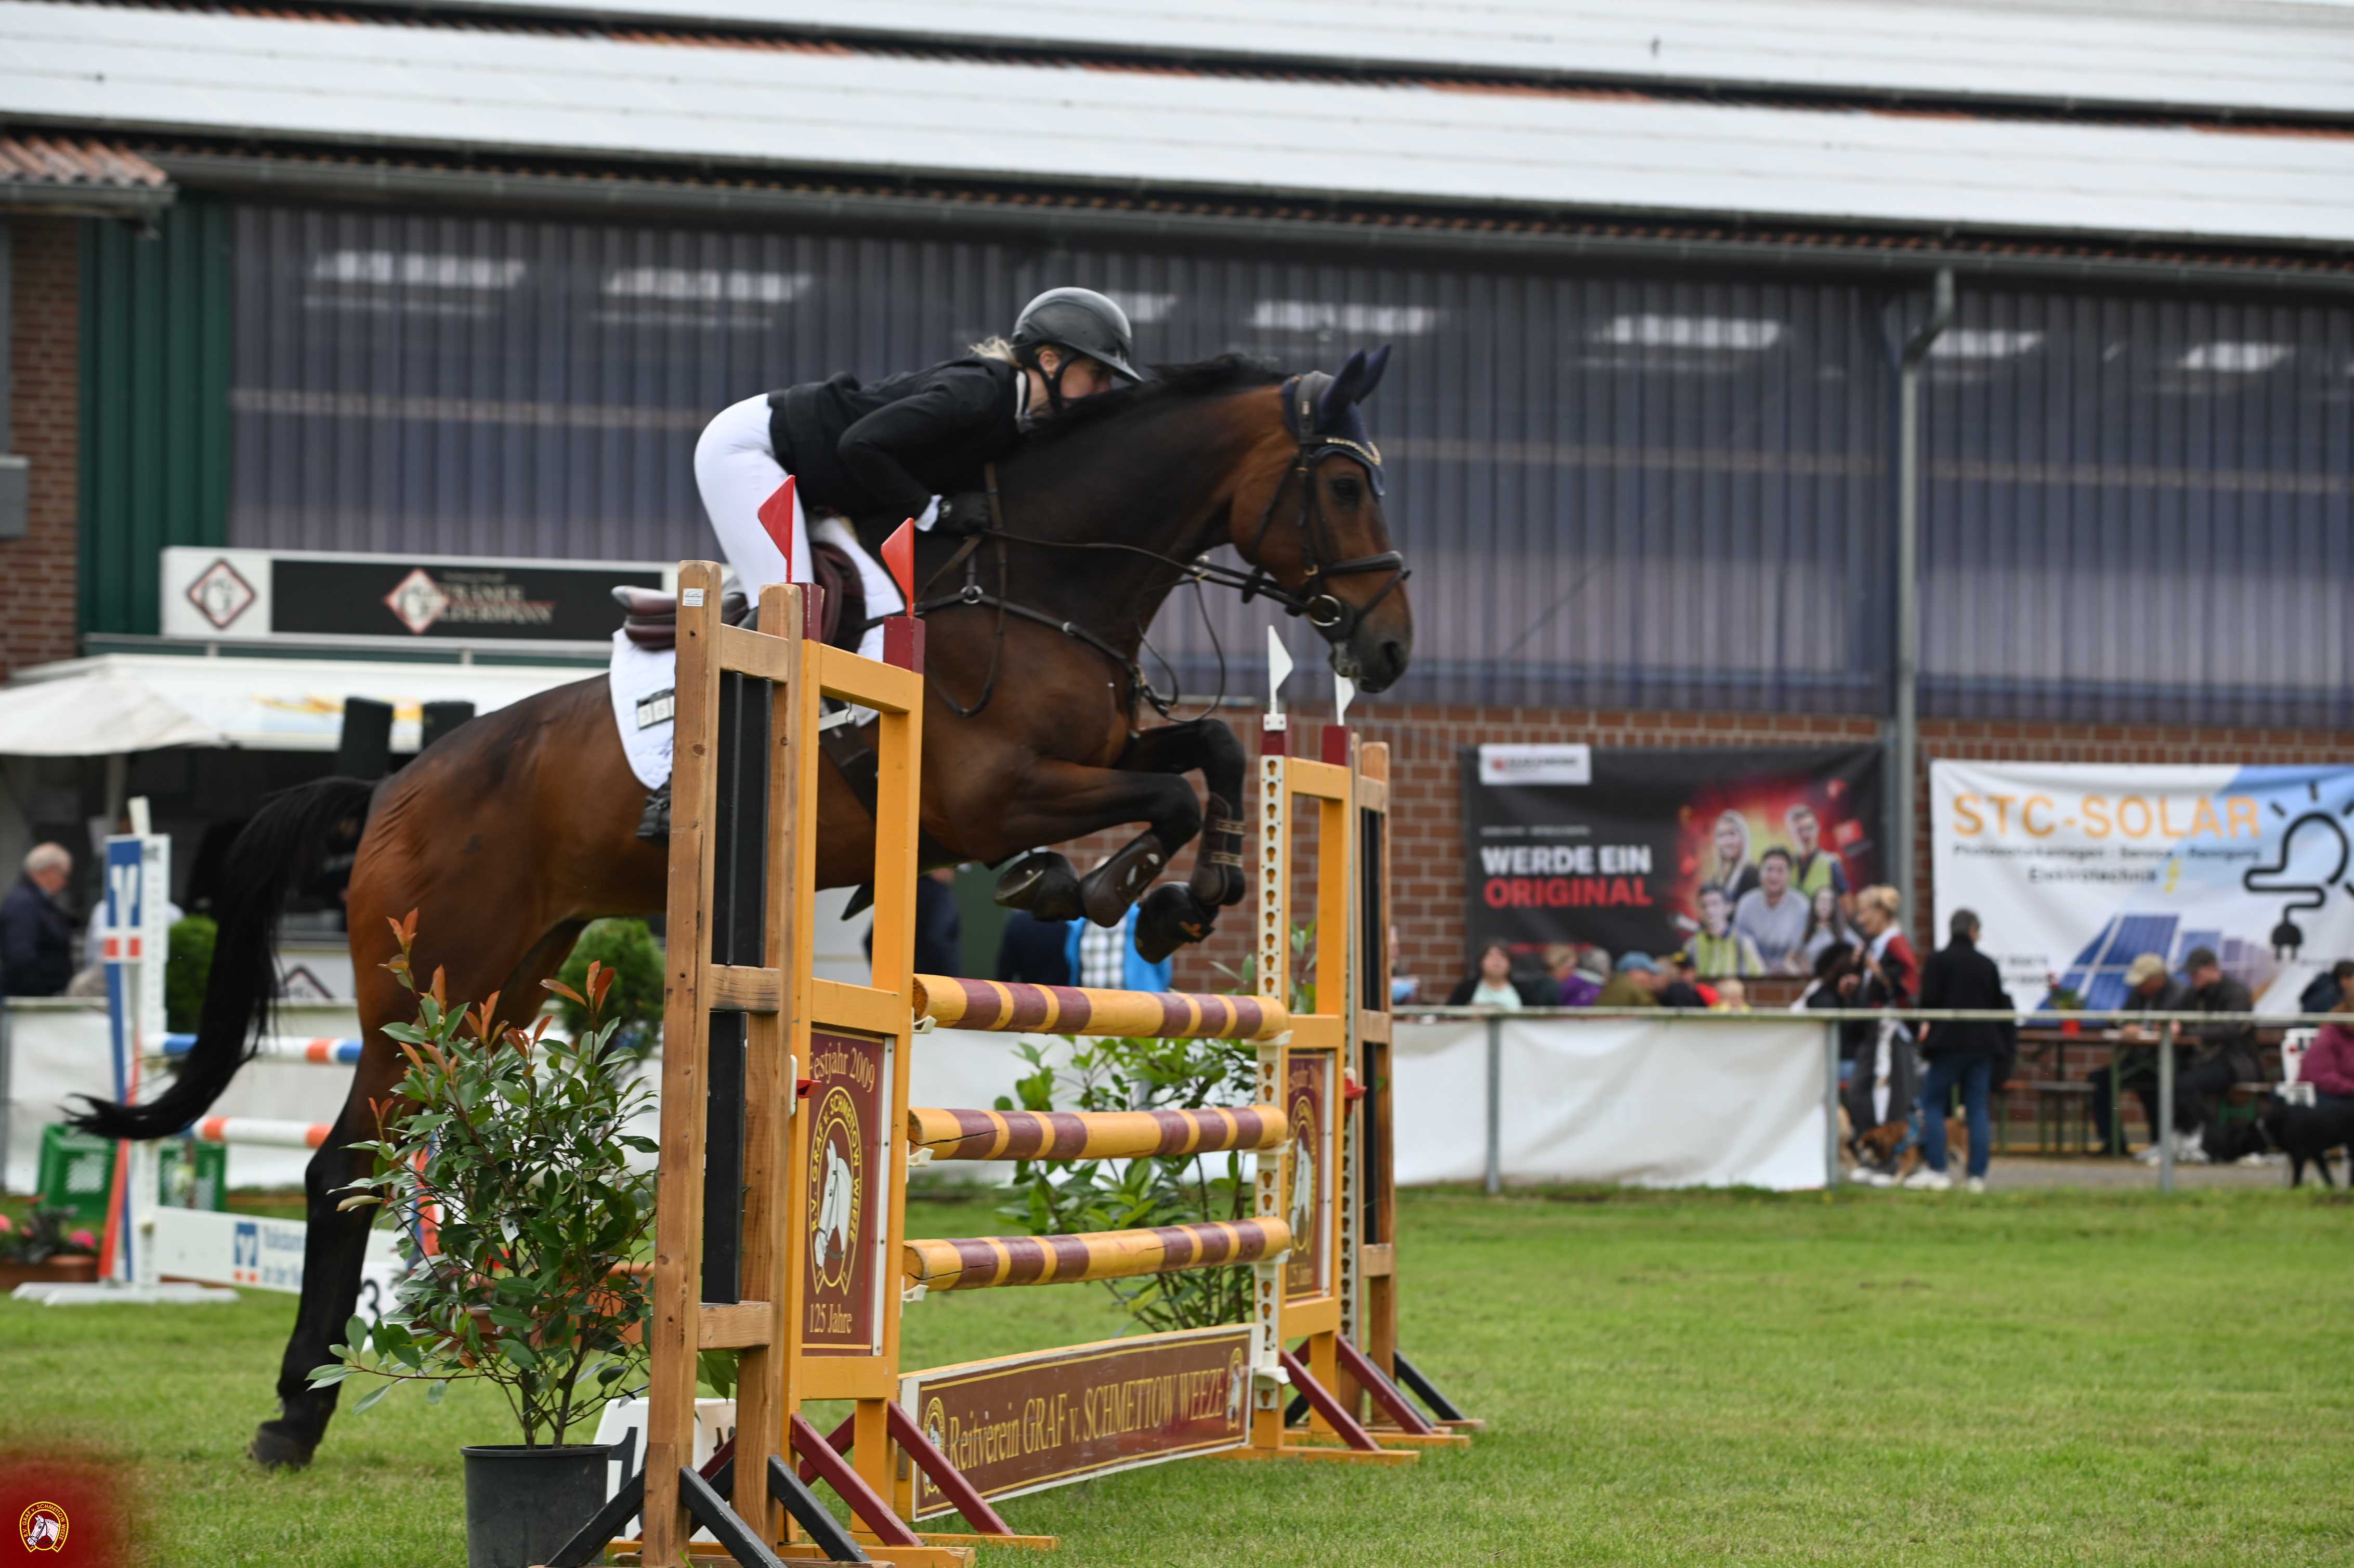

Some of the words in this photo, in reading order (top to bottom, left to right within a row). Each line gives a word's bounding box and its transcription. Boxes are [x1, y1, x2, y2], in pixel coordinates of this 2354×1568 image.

[1953, 792, 2260, 840] STC-SOLAR
[1481, 844, 1594, 876] WERDE
[1599, 843, 1652, 874] EIN
[1484, 877, 1654, 907] ORIGINAL
[849, 1047, 874, 1092] 2009
[849, 1178, 860, 1243] WEEZE
[809, 1303, 826, 1333] 125
[827, 1303, 852, 1334] Jahre
[949, 1402, 1019, 1471] Reitverein
[1023, 1393, 1067, 1454] GRAF
[1069, 1407, 1079, 1444] v.
[1083, 1375, 1177, 1441] SCHMETTOW
[1179, 1368, 1225, 1422] WEEZE
